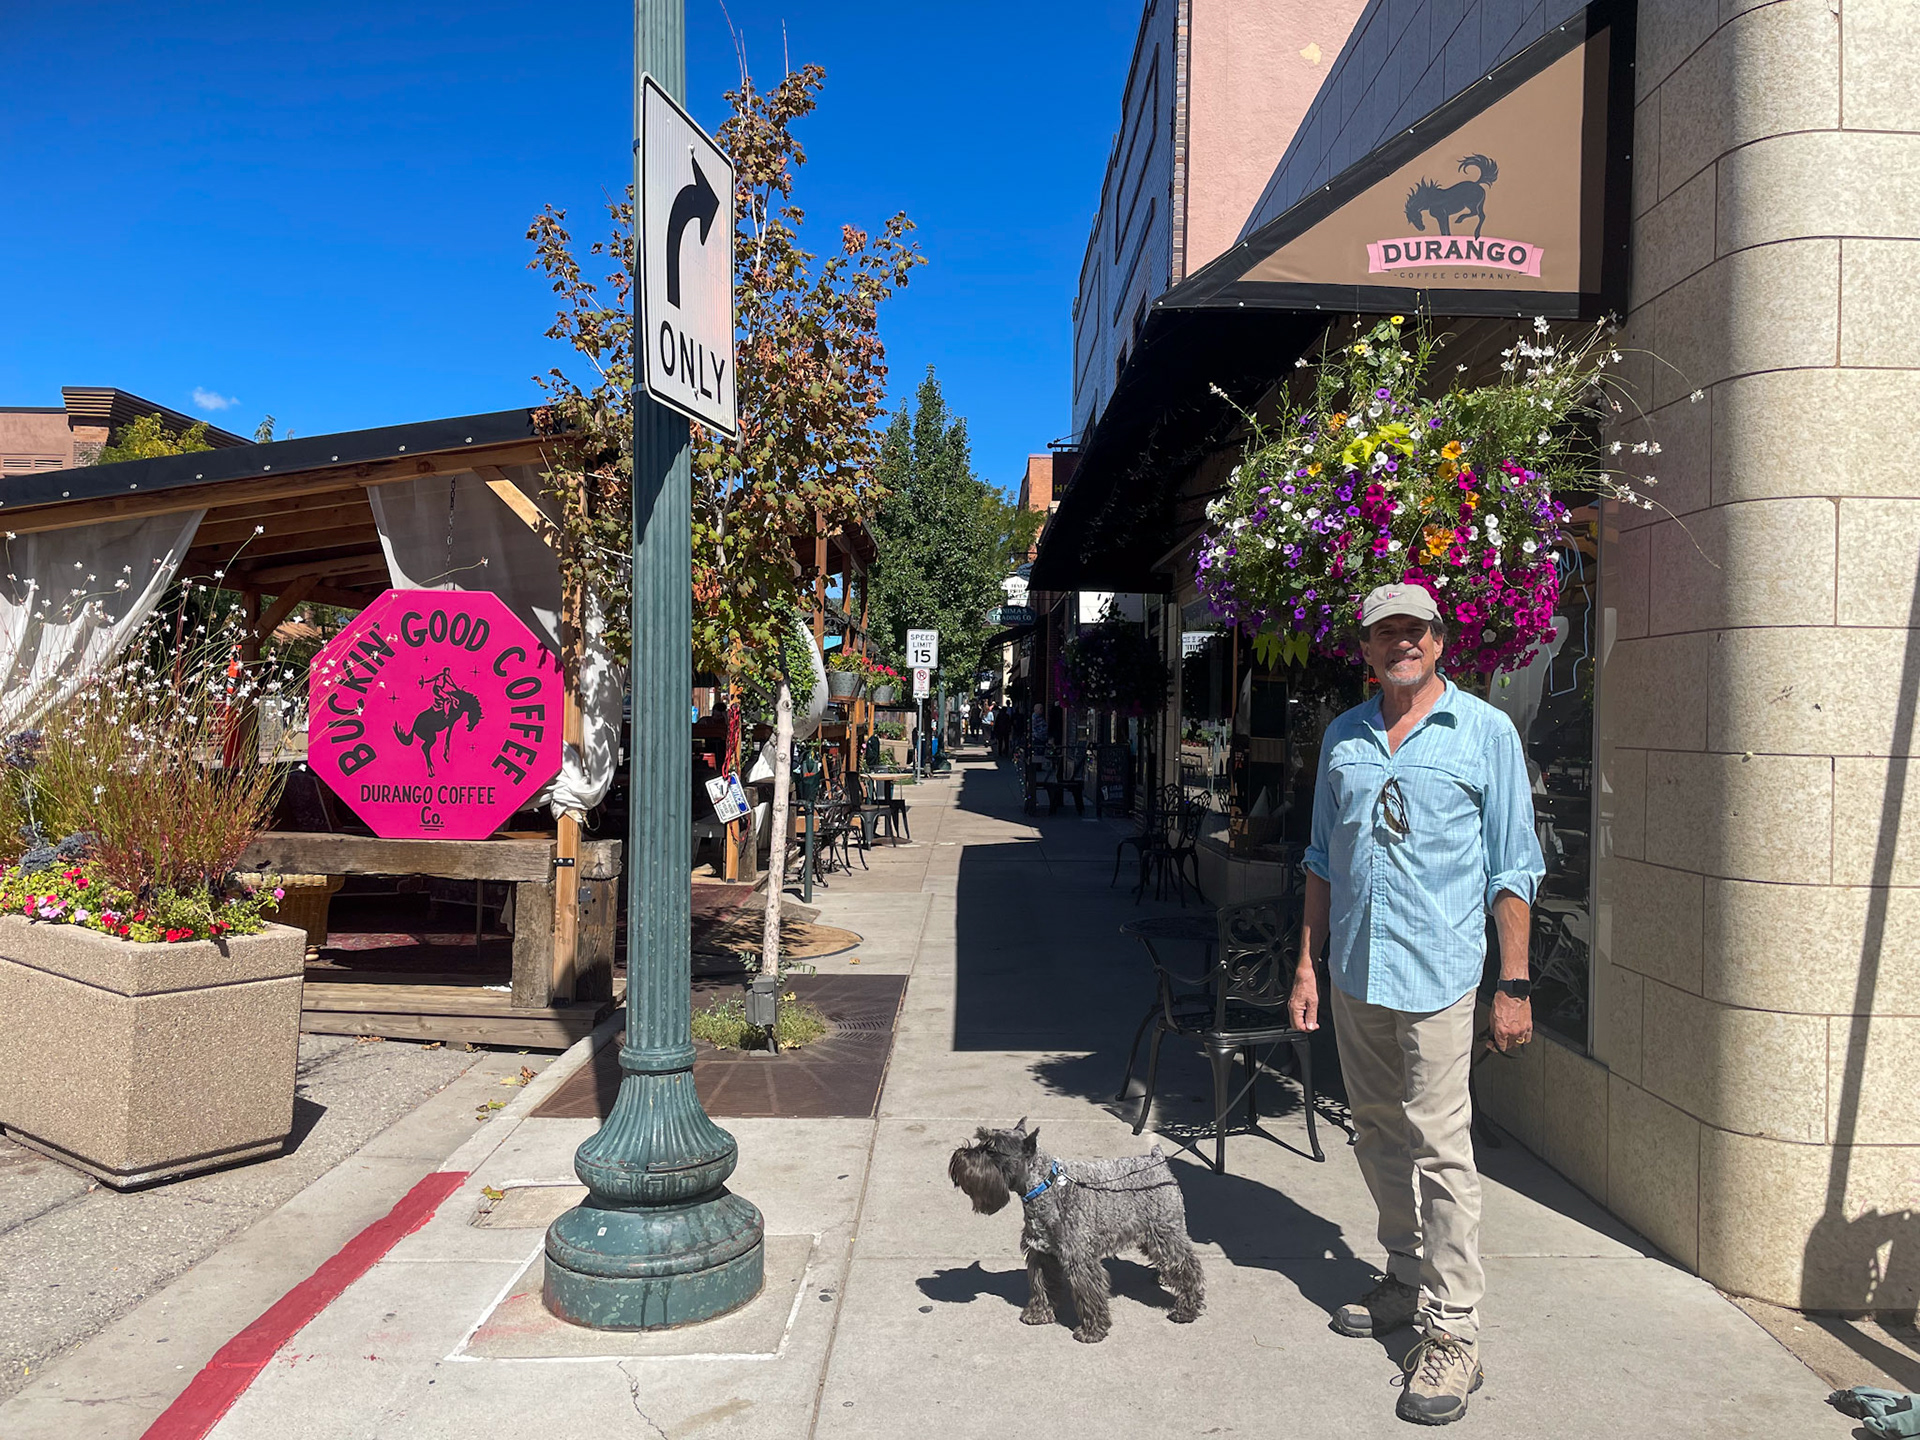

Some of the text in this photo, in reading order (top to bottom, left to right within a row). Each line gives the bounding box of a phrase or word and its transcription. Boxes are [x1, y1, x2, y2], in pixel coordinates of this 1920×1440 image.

[1382, 239, 1527, 265] DURANGO
[660, 320, 726, 405] ONLY
[991, 614, 1021, 622] TRADING
[996, 607, 1028, 615] ANIMAS
[910, 633, 936, 641] SPEED
[914, 649, 931, 663] 15
[327, 609, 546, 786] BUCKIN' GOOD COFFEE
[360, 784, 496, 805] DURANGO COFFEE
[420, 805, 444, 825] Co.
